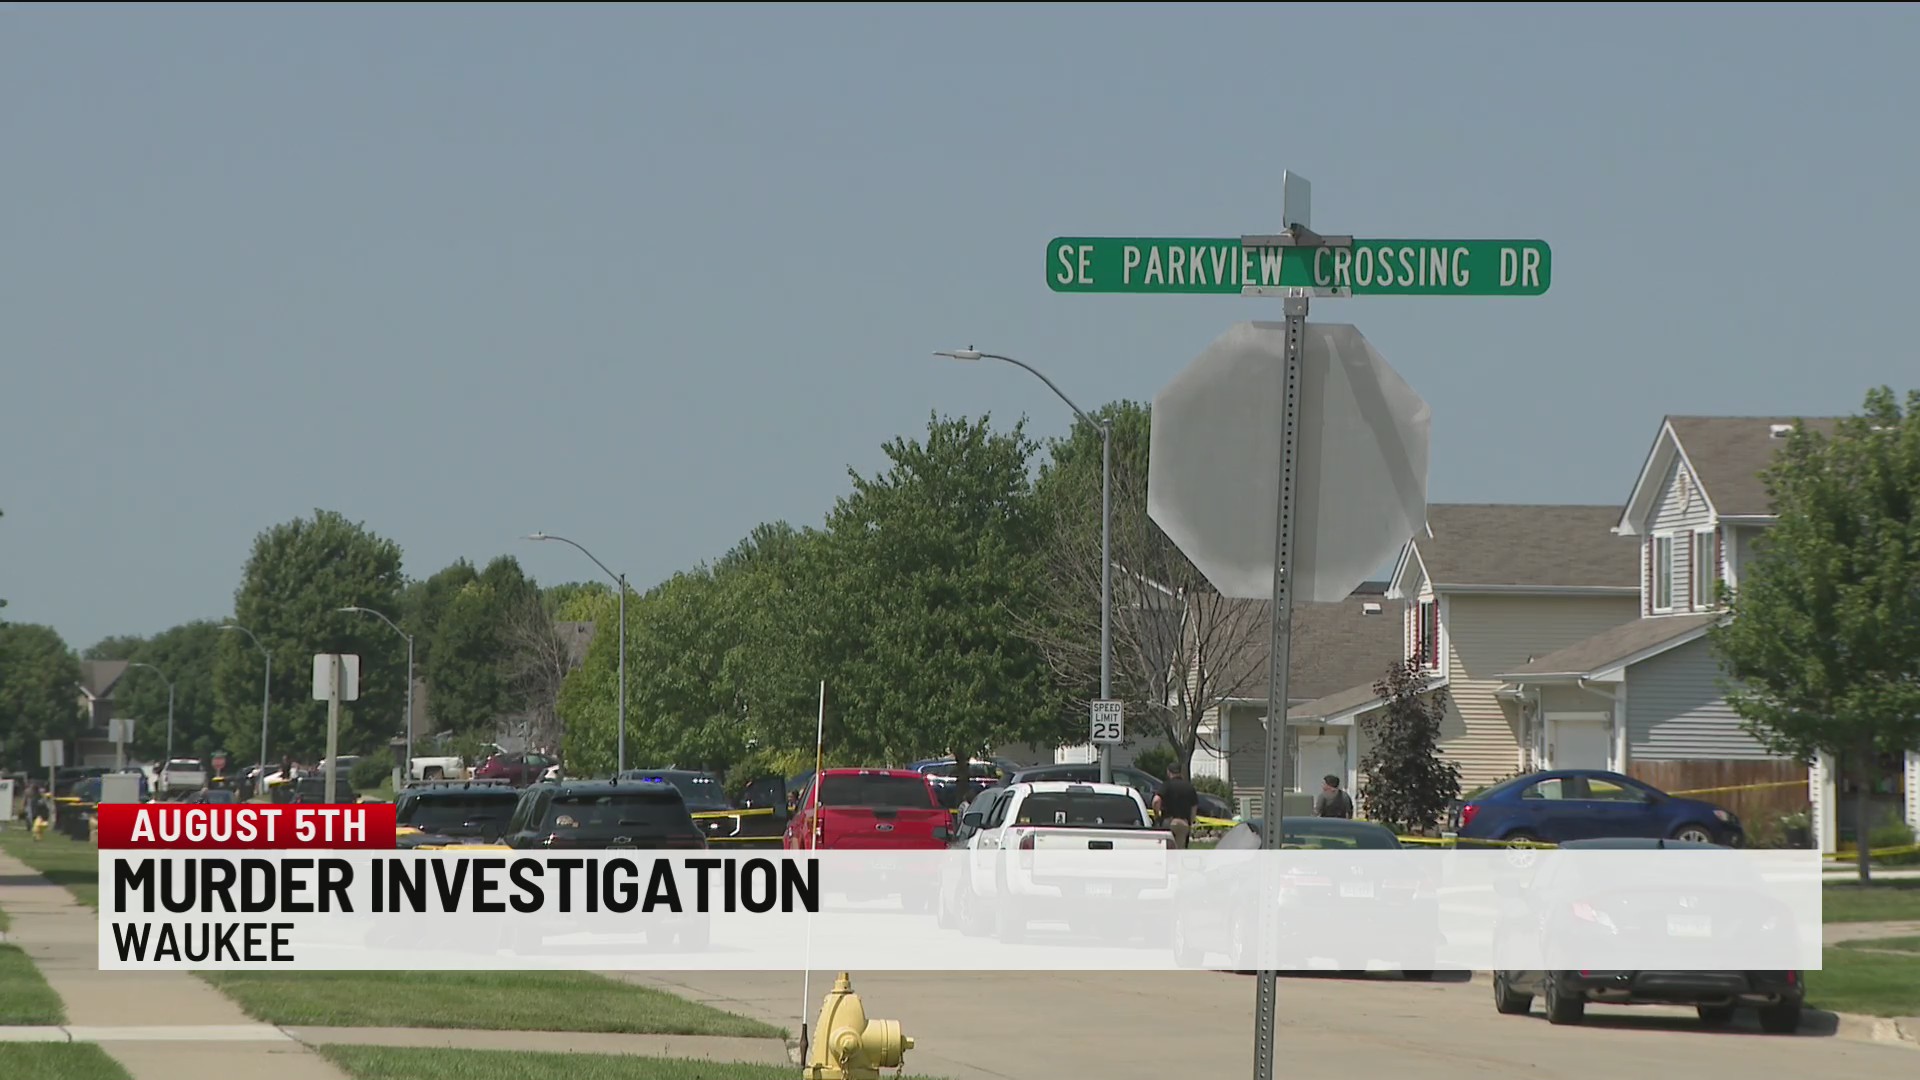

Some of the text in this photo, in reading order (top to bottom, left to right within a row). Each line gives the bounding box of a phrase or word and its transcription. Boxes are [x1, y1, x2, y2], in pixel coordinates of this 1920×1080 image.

[1056, 245, 1541, 287] SE PARKVIEW CROSSING DR
[1094, 703, 1121, 712] SPEED
[1095, 713, 1118, 722] LIMIT
[1093, 723, 1120, 739] 25
